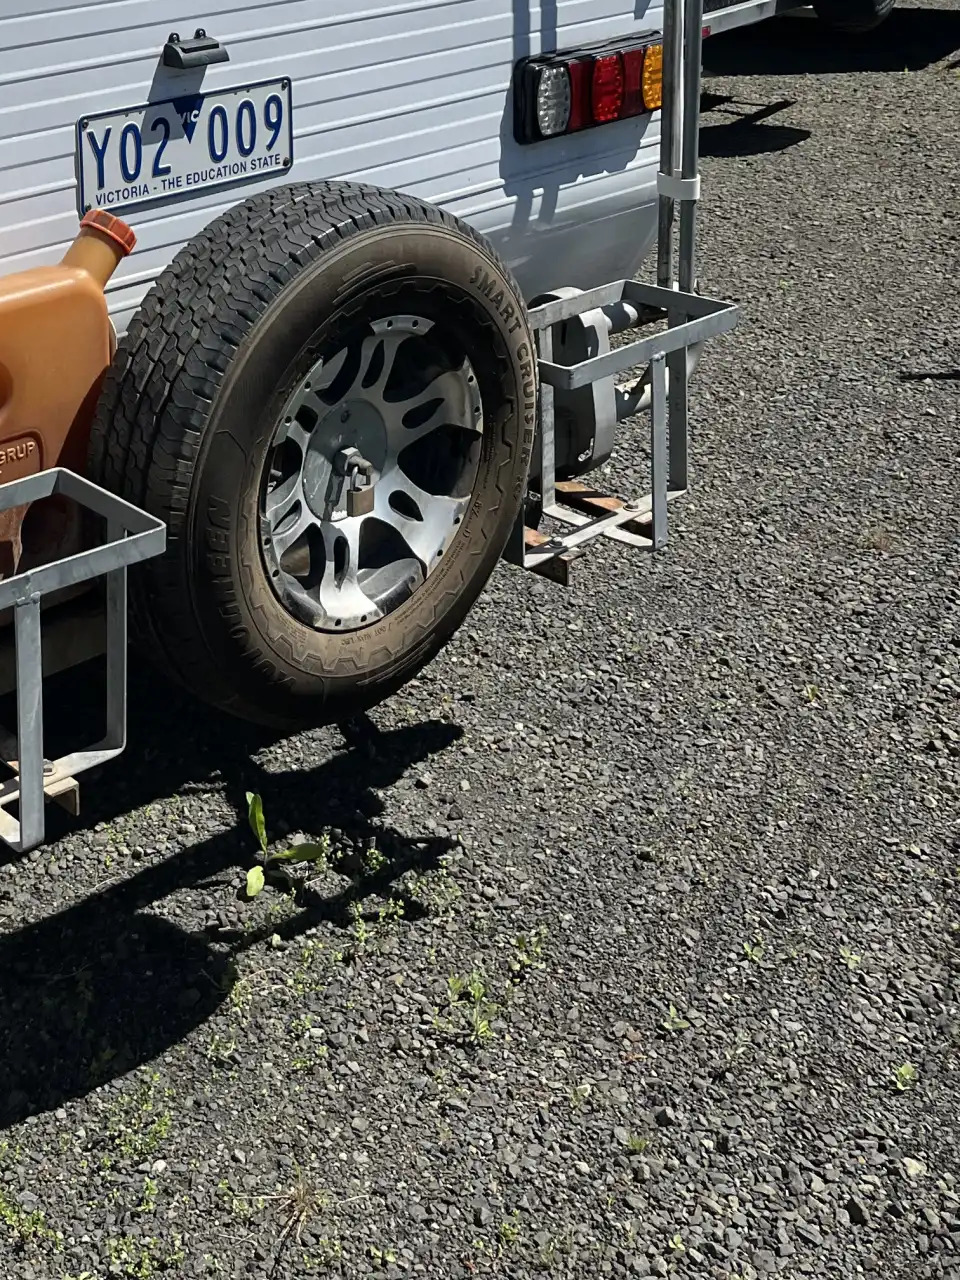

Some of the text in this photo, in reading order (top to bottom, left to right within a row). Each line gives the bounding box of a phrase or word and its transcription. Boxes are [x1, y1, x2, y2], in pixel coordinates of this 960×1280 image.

[208, 93, 283, 163] 009
[95, 183, 150, 206] VICTORIA
[161, 175, 183, 191] THE
[186, 161, 247, 186] EDUCATION
[250, 153, 281, 171] STATE
[469, 266, 522, 335] SMART
[516, 342, 534, 467] CRUISER
